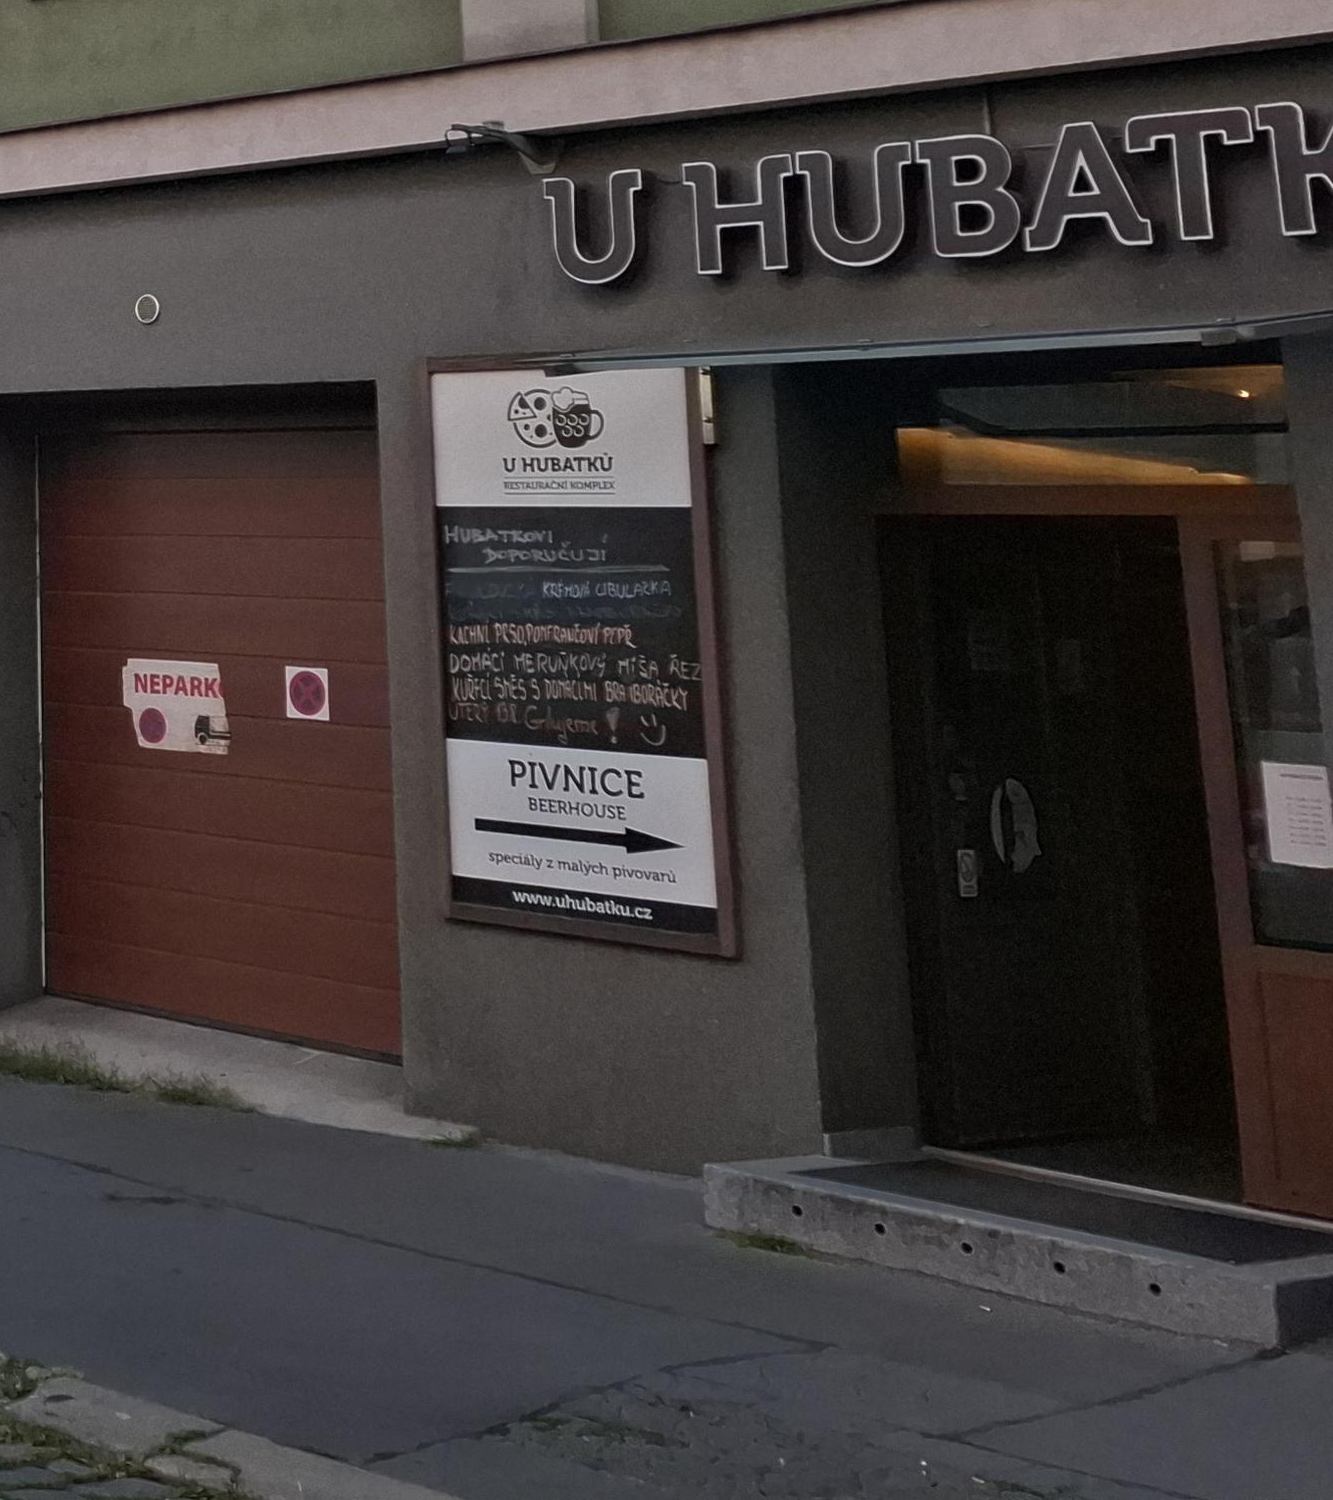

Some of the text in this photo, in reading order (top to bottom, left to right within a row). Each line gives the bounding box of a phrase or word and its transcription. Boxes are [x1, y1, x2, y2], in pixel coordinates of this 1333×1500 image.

[541, 167, 642, 285] U
[502, 452, 614, 473] U HUBATKŮ
[503, 478, 616, 490] RESTAURAČNÍ KOMPLEX
[444, 524, 553, 545] HUBATKOVI
[450, 647, 505, 674] DOMÁCÍ
[507, 759, 645, 799] PIVNICE
[528, 797, 627, 821] BEERHOUSE
[488, 851, 677, 884] speciály z malých pivovarů
[512, 889, 653, 921] www.uhubatku.cz
